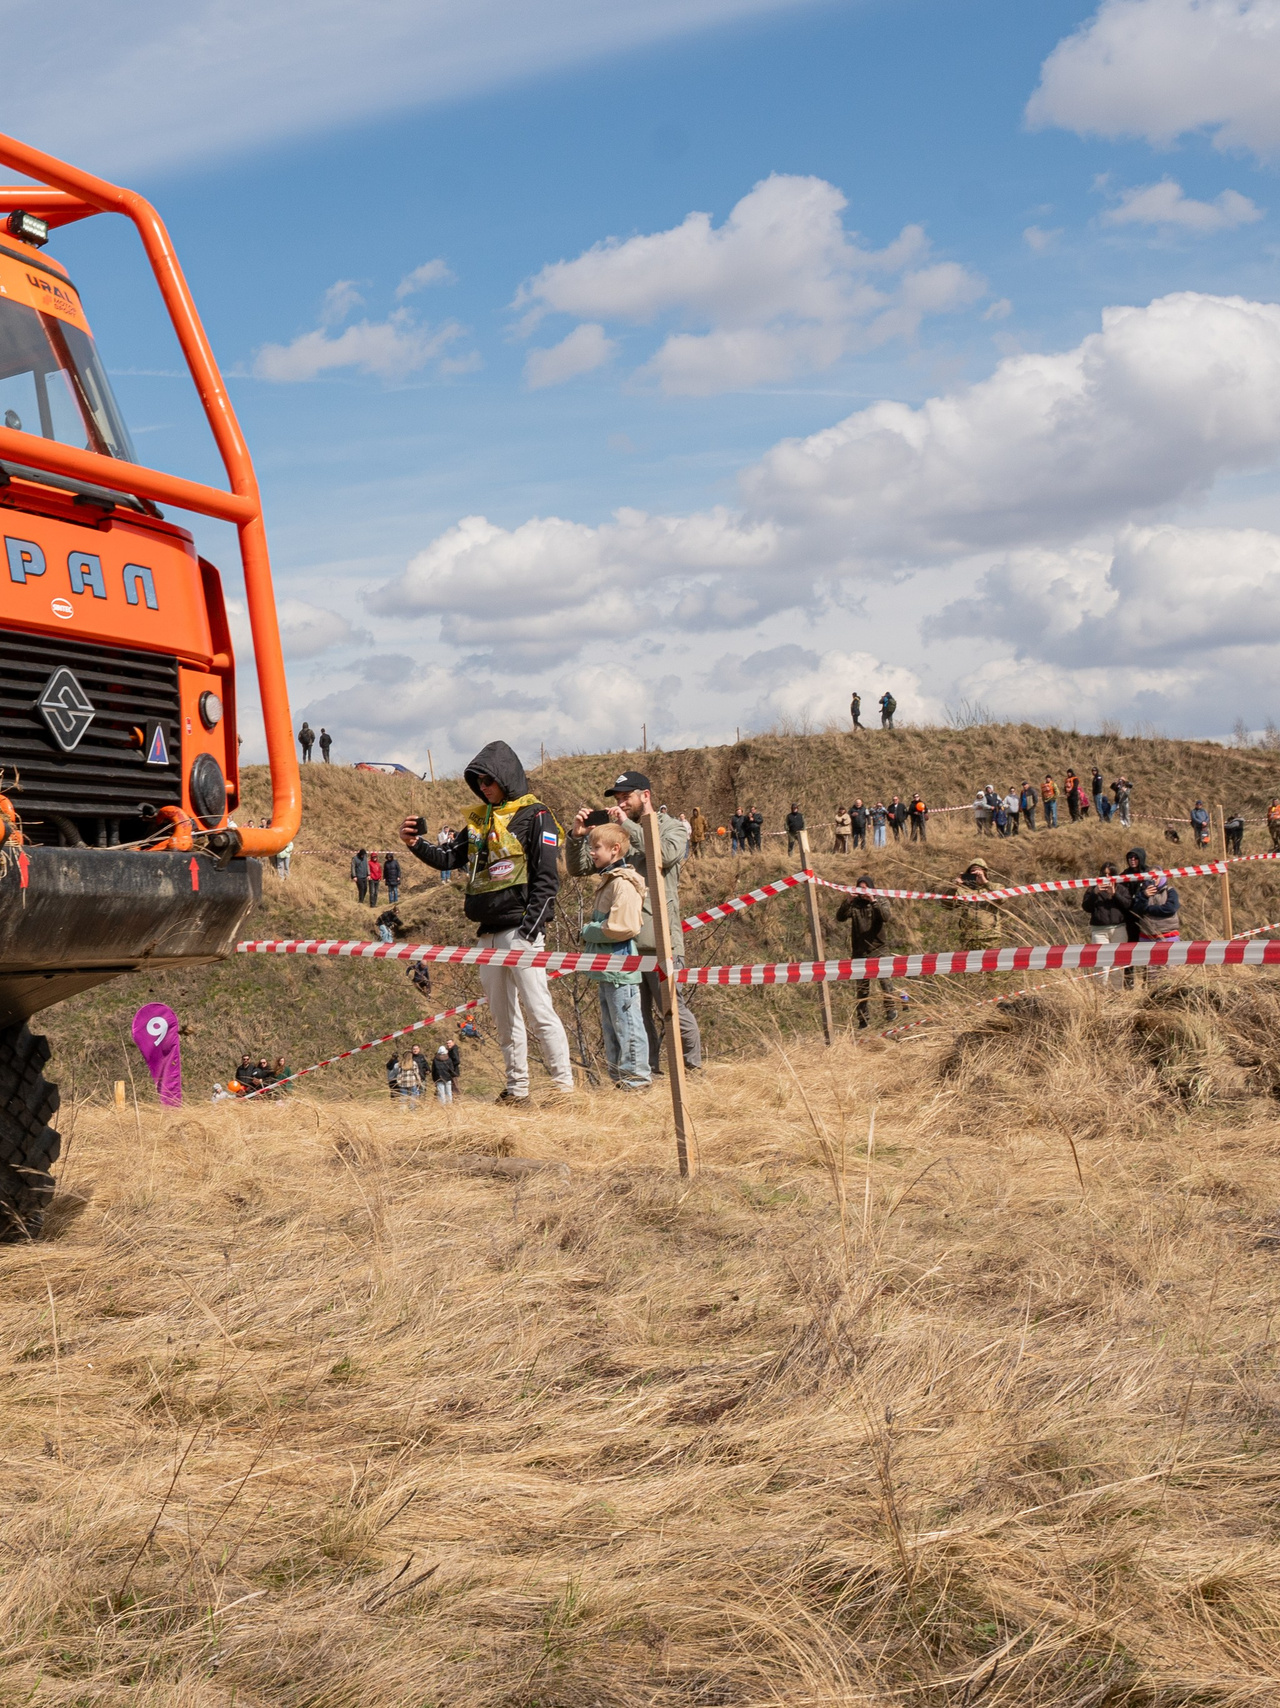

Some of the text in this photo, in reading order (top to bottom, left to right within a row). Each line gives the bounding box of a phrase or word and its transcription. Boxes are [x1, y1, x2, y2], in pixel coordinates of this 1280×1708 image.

[26, 273, 73, 305] URAL
[489, 863, 512, 873] SINTEC
[146, 1016, 169, 1047] 9
